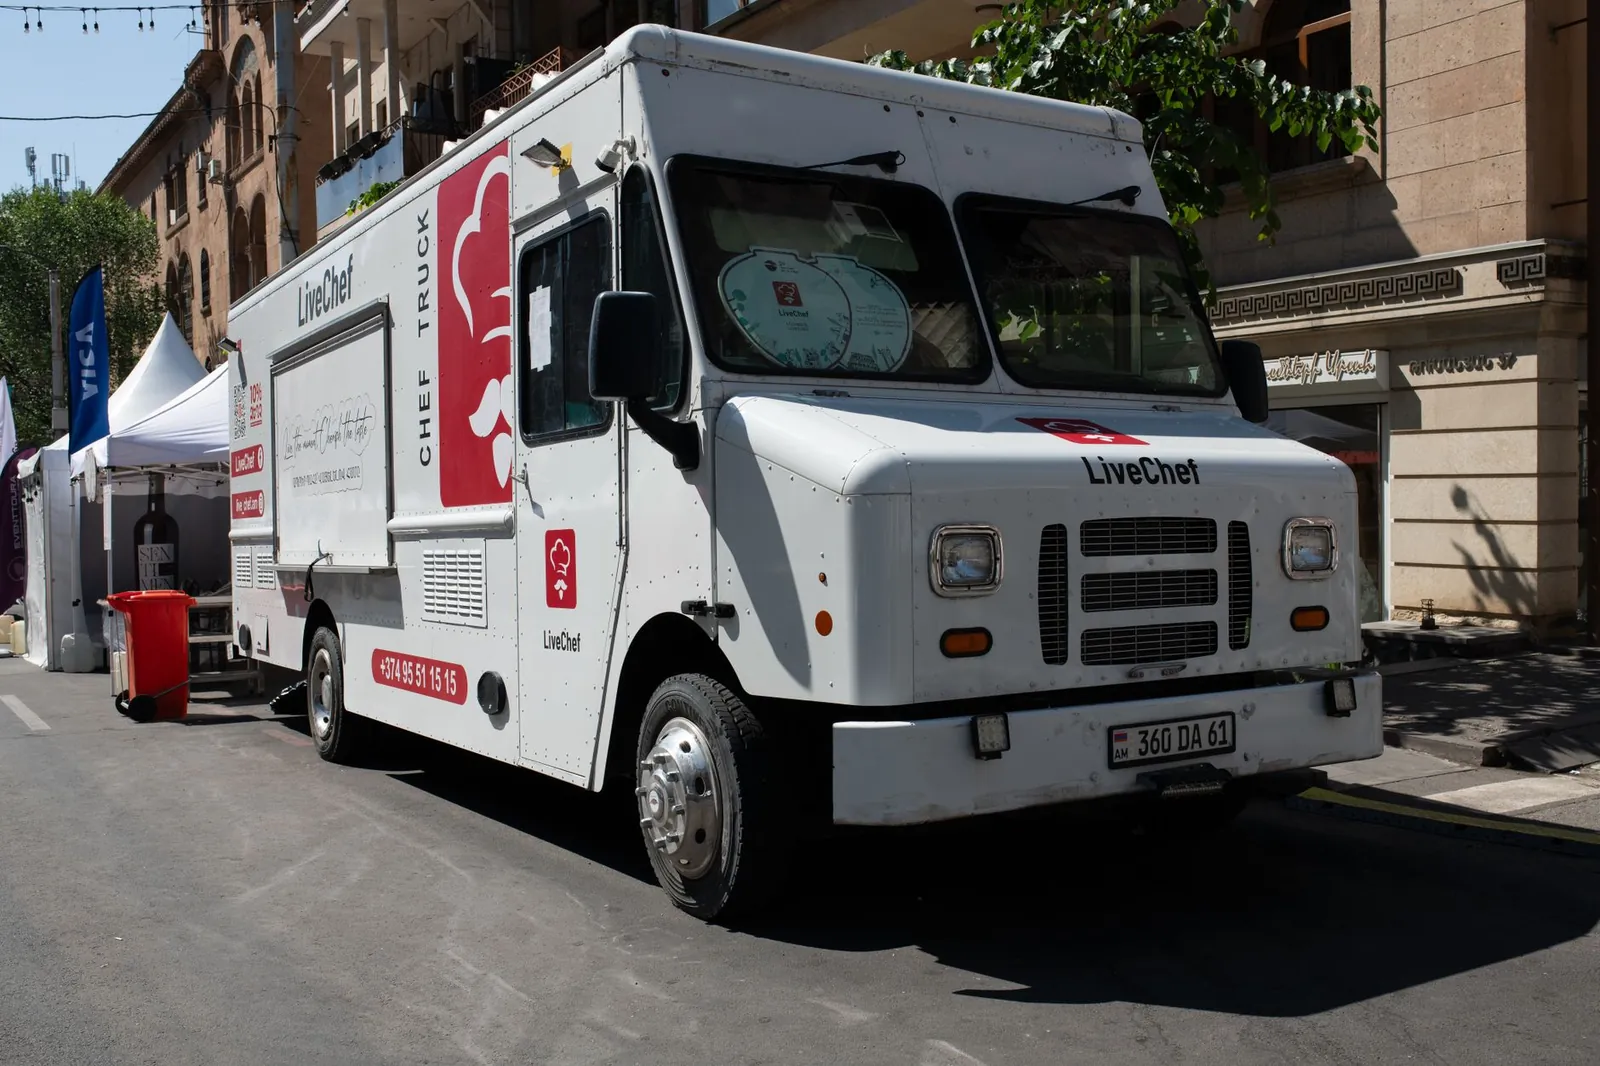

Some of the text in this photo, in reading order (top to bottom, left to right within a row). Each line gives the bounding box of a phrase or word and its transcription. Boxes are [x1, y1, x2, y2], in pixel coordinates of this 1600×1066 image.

[298, 253, 353, 327] LiveChef
[778, 308, 809, 318] LiveChef
[417, 208, 431, 467] CHEF TRUCK
[75, 321, 99, 401] VISA
[1080, 456, 1200, 485] LiveChef
[543, 630, 581, 652] LiveChef
[380, 656, 457, 696] +374 95 51 15 15
[1114, 719, 1228, 760] AM 360 DA 61
